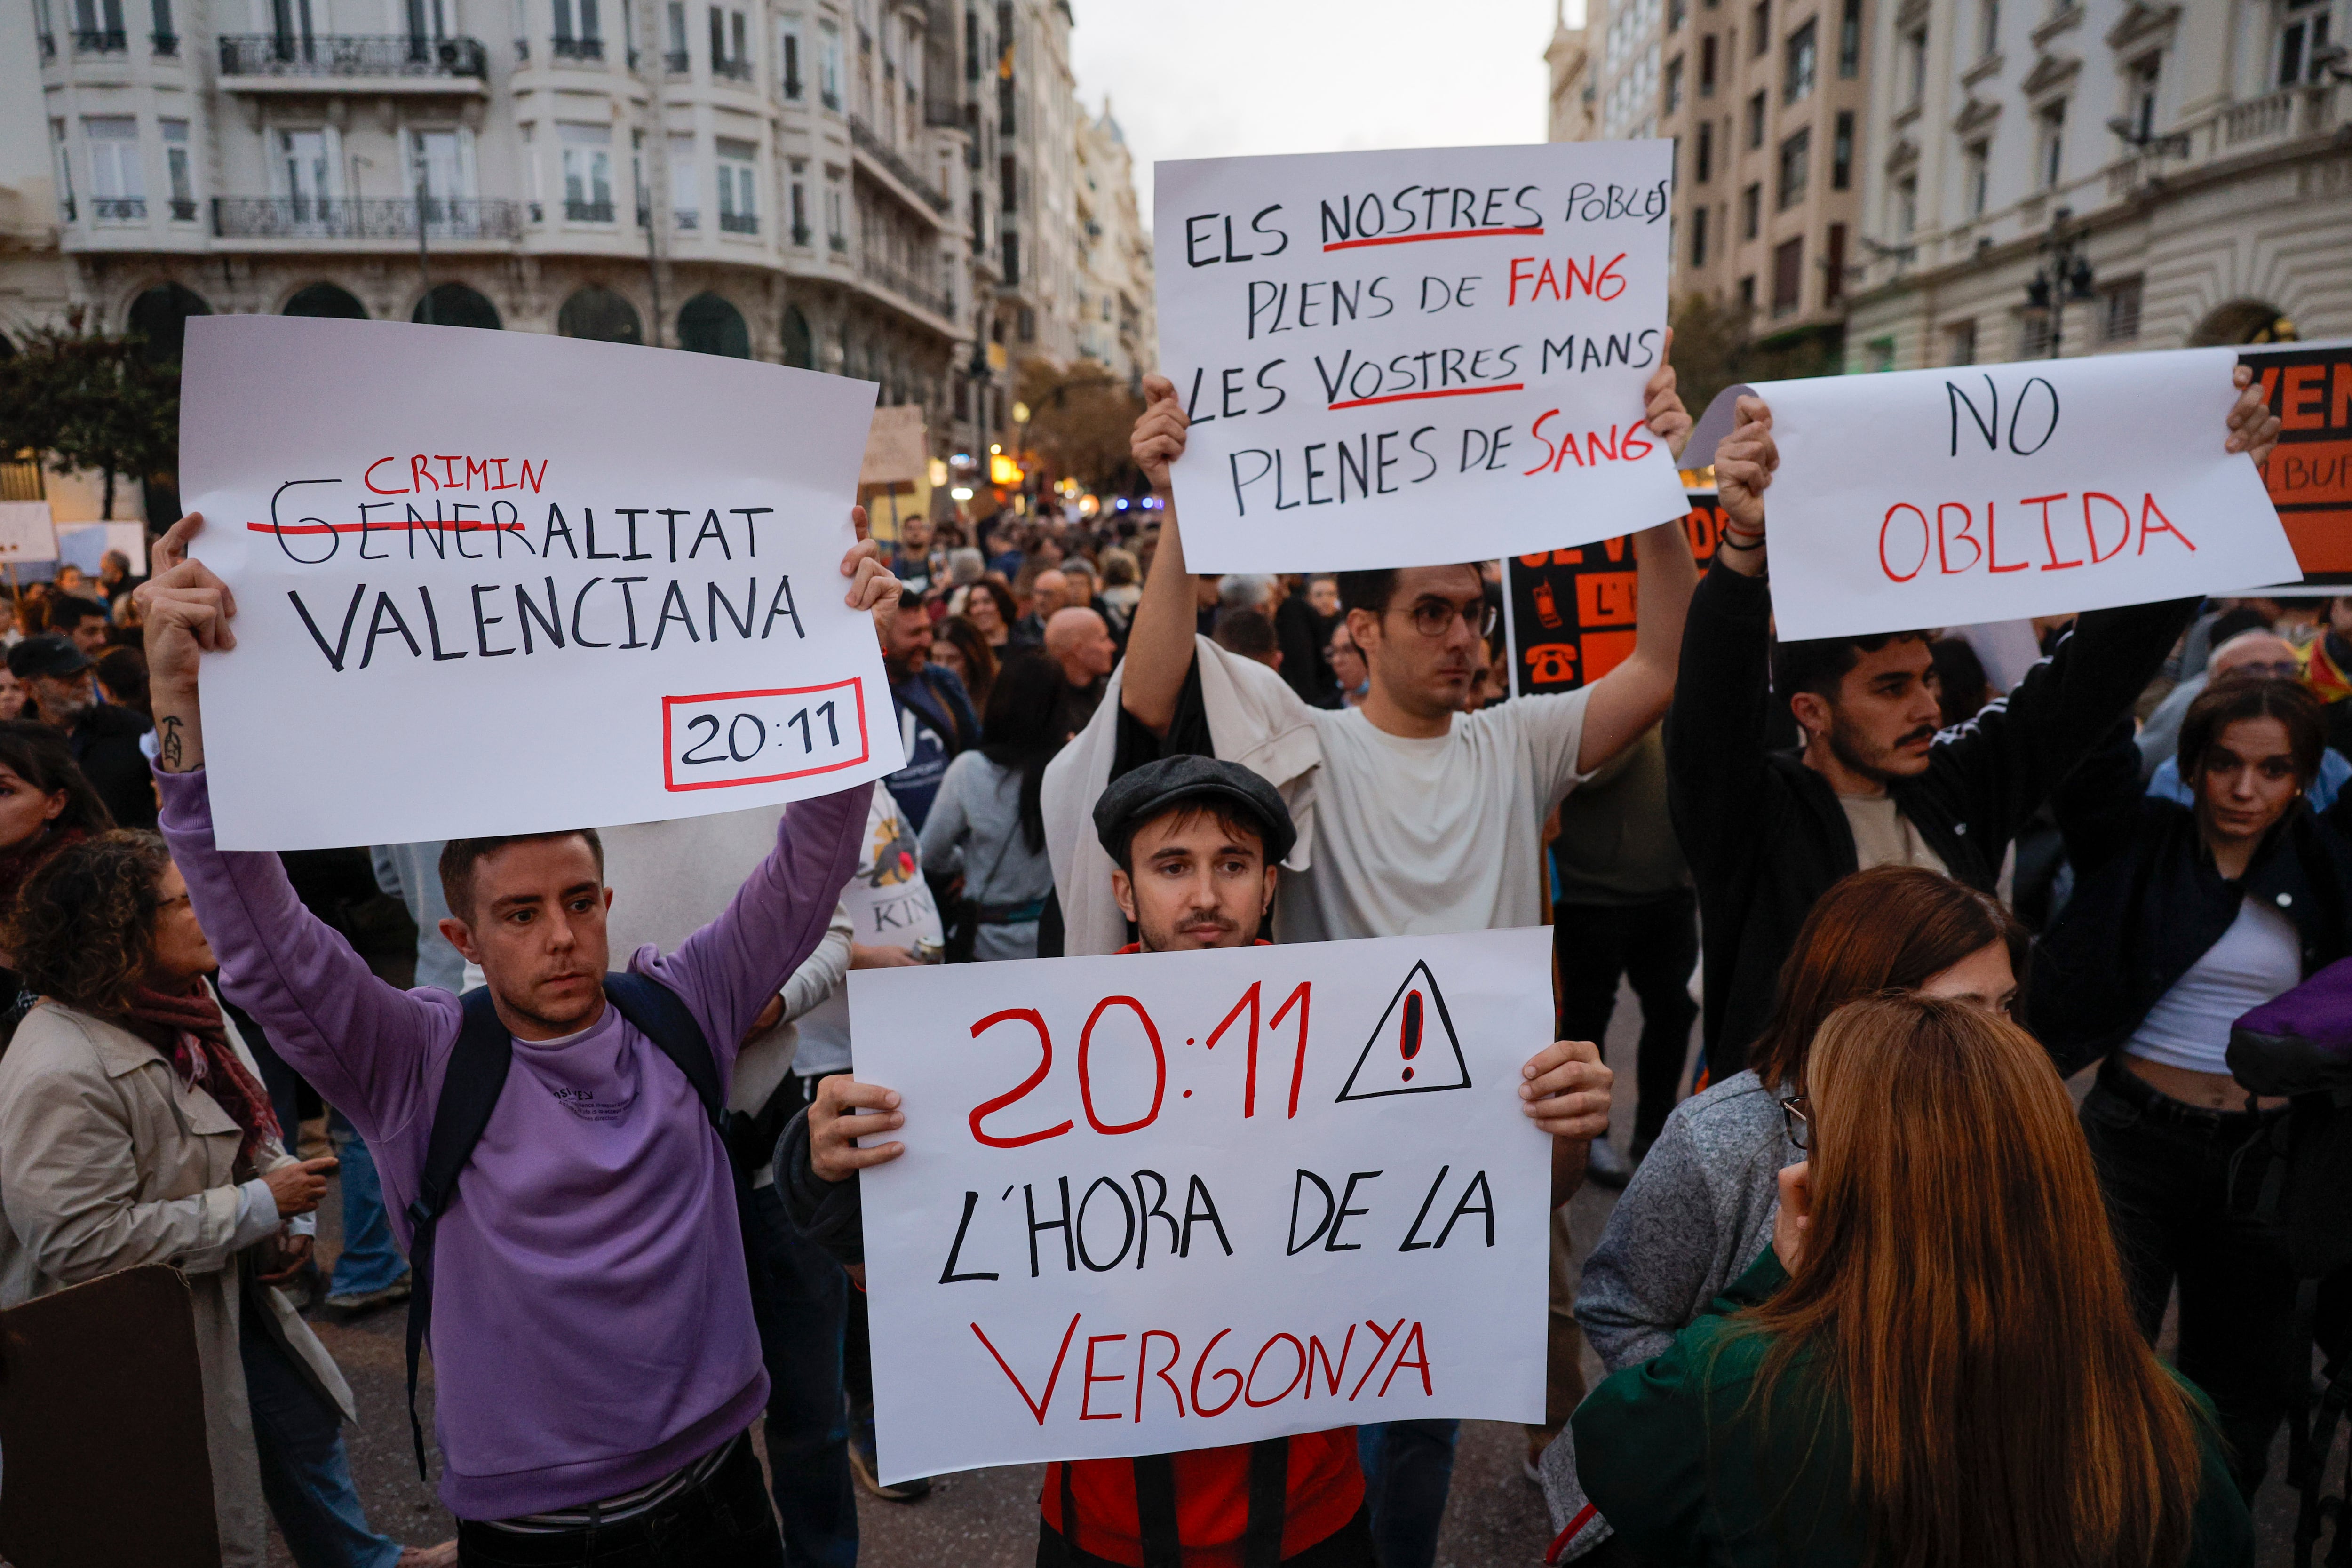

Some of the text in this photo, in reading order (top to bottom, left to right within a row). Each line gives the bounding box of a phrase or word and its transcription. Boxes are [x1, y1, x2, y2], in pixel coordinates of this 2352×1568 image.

[1186, 180, 1669, 268] ELS NOSTRES POBLES
[1248, 253, 1627, 340] PLENS DE FANG
[1187, 329, 1659, 426] LES VOSTRES MANS
[1947, 375, 2059, 457] NO
[365, 454, 548, 495] CRIMIN
[1229, 408, 1654, 517] PLENES DE SANG
[271, 479, 774, 564] GENERALITAT
[1879, 492, 2196, 583] OBLIDA
[287, 575, 805, 673] VALENCIANA
[682, 701, 839, 763] 20:11
[969, 980, 1312, 1149] 20:11
[938, 1165, 1495, 1284] L'HORA DE LA
[970, 1313, 1433, 1425] VERGONYA
